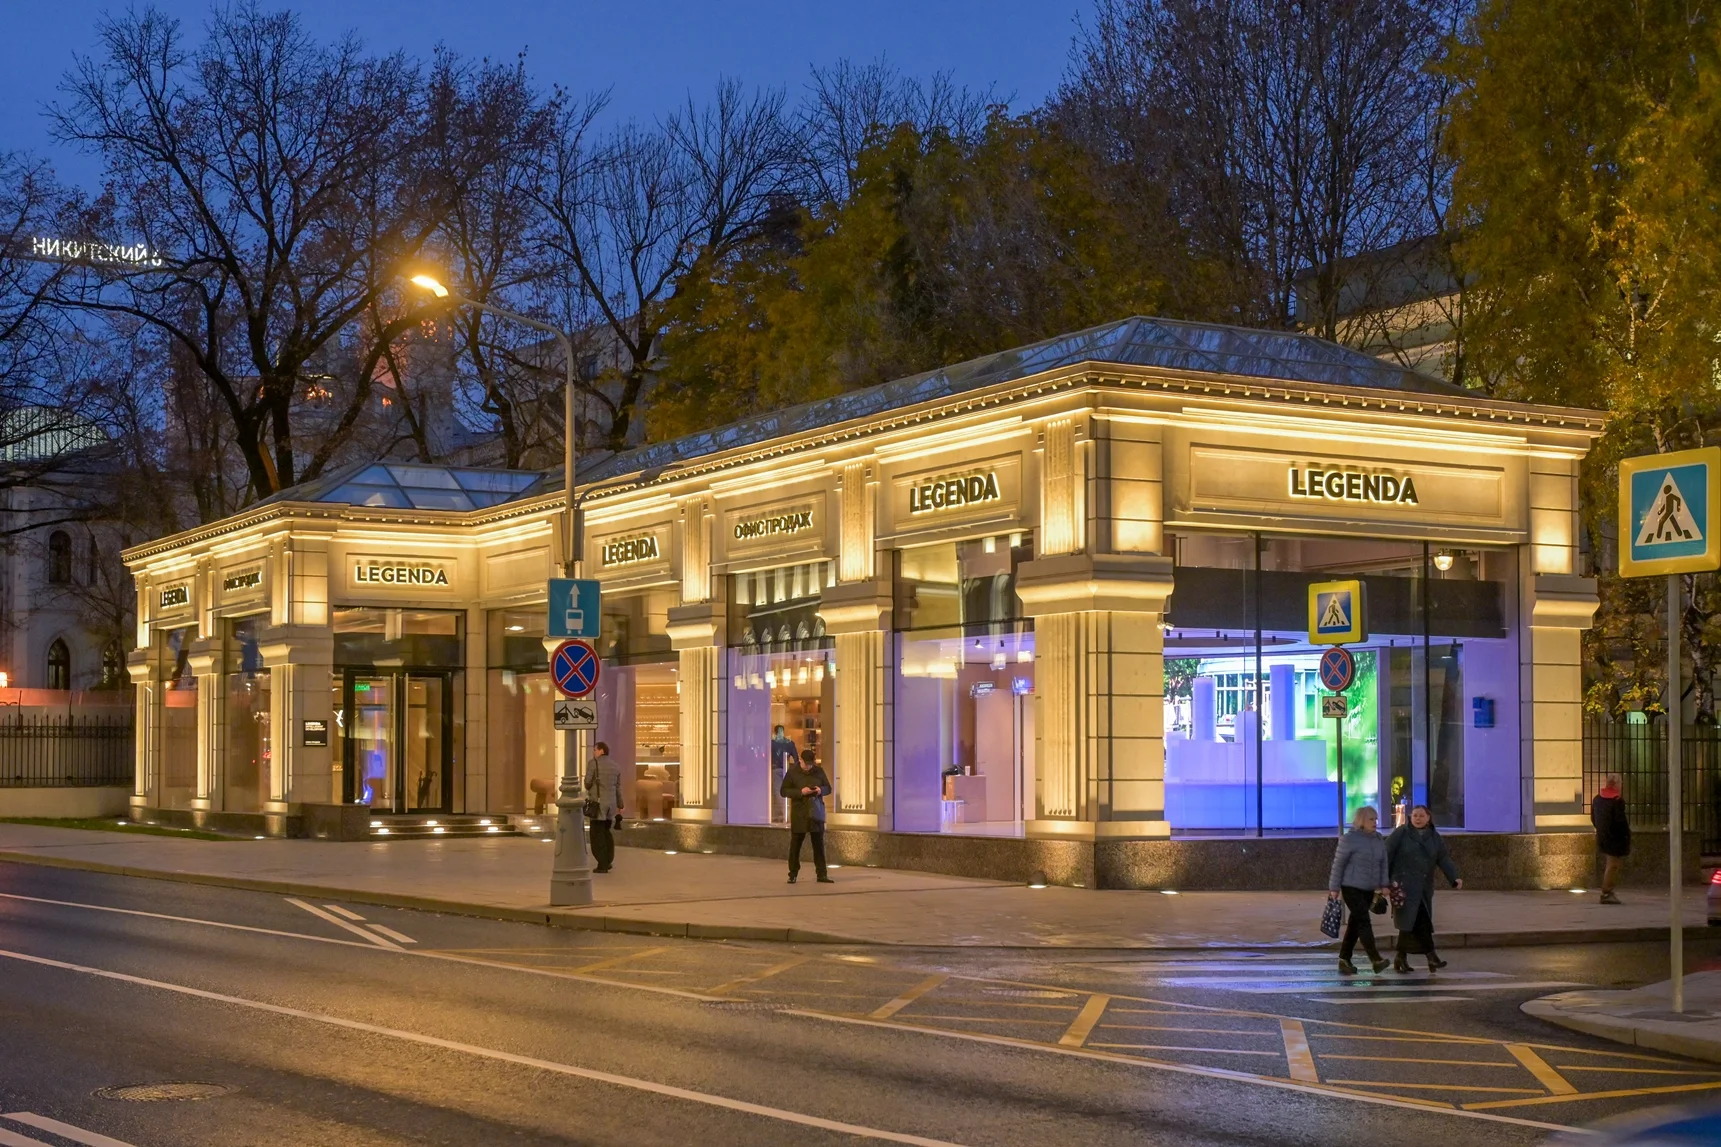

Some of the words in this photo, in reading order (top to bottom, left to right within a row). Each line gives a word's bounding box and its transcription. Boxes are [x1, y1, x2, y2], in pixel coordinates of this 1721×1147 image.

[909, 472, 1000, 514] LEGENDA
[1289, 468, 1419, 504] LEGENDA
[734, 519, 765, 540] ОФИС
[765, 511, 813, 535] ПРОДАЖ
[602, 536, 659, 567] LEGENDA
[355, 566, 449, 586] LEGENDA
[160, 587, 190, 608] LEGENDA
